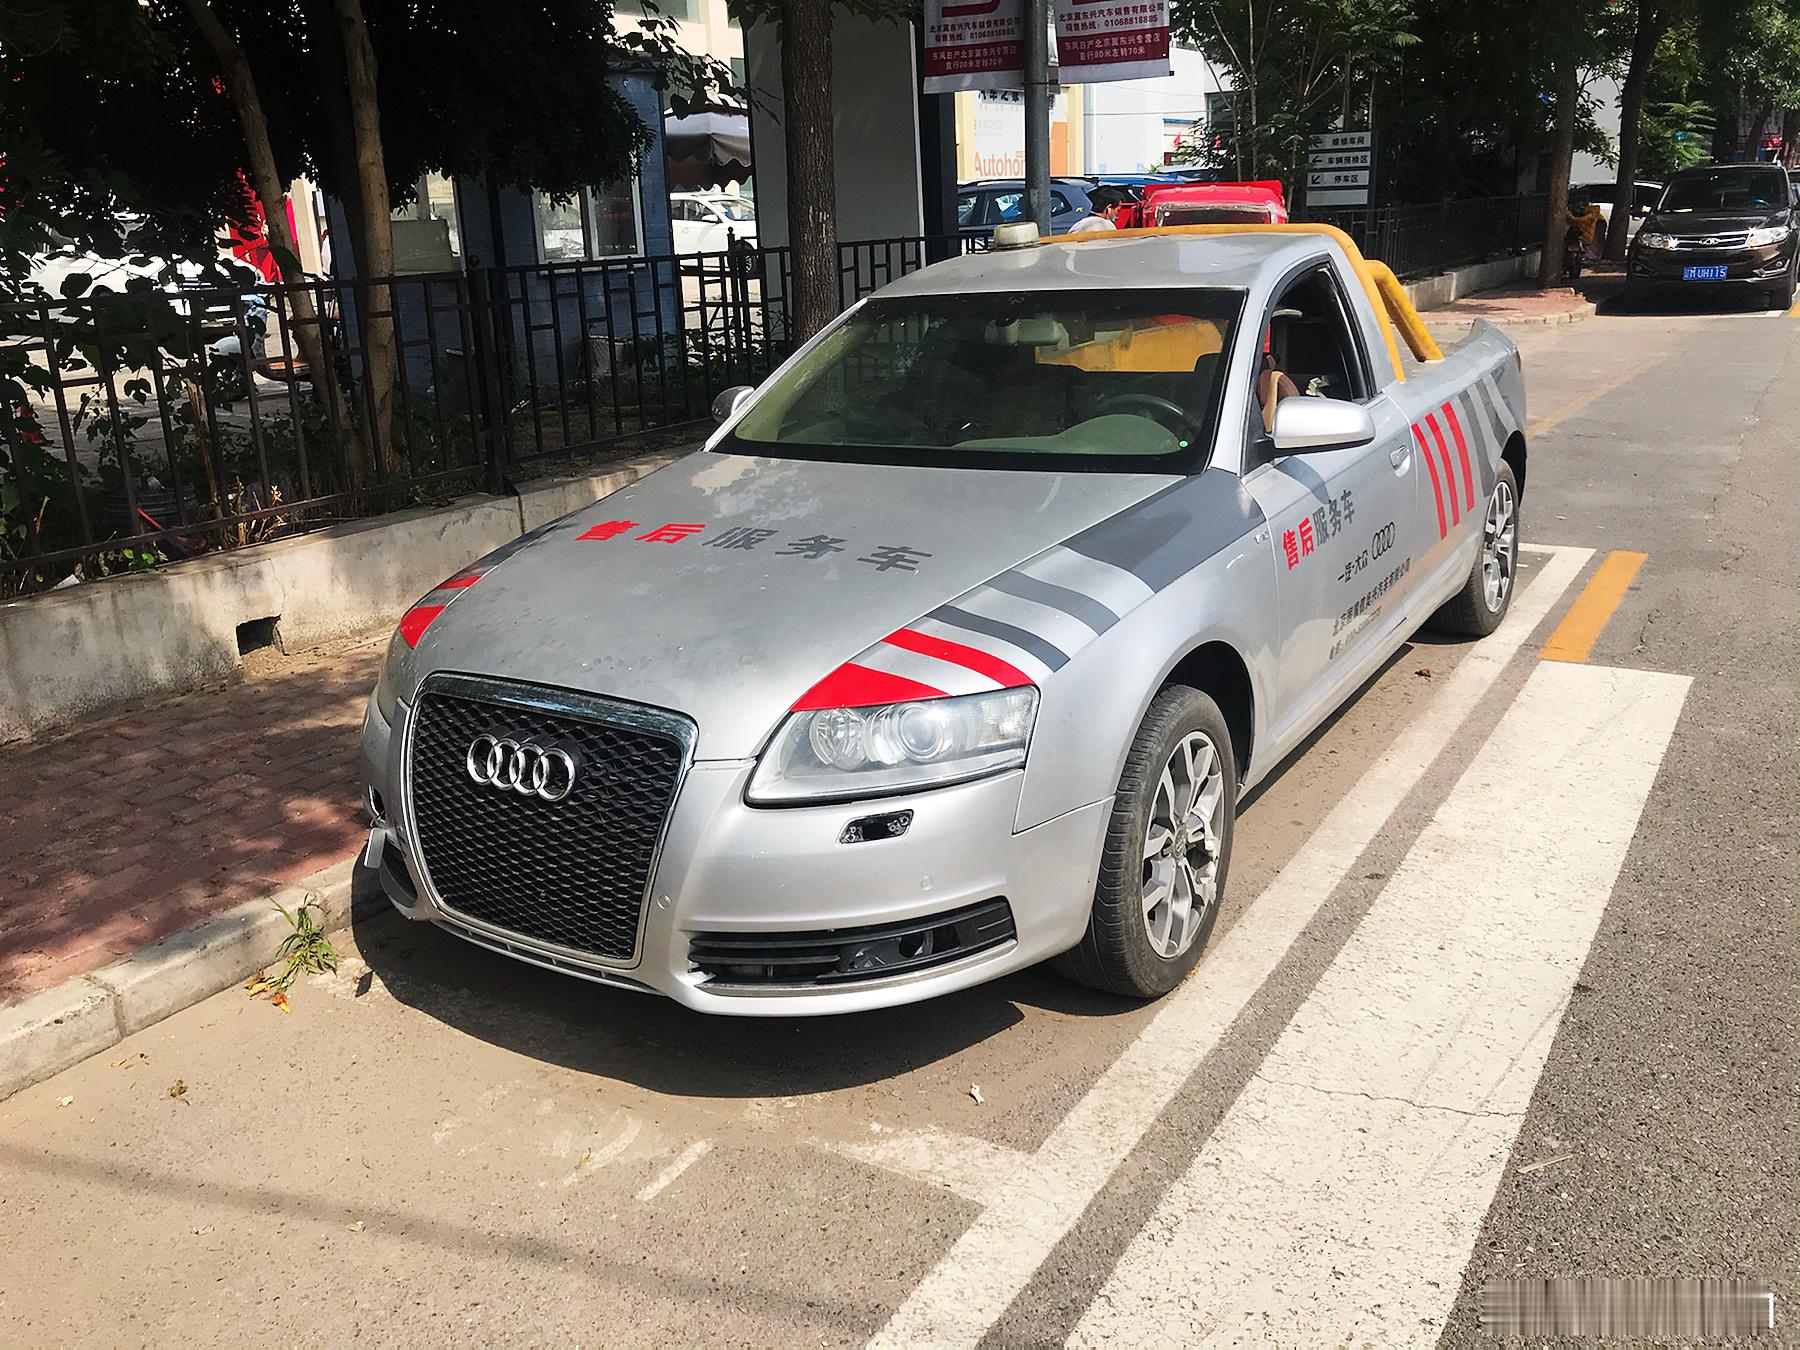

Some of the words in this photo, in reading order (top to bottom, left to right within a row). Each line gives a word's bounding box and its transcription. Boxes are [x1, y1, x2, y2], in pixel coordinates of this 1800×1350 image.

[575, 519, 933, 572] 售后服务车
[1283, 489, 1355, 571] 售后服务车
